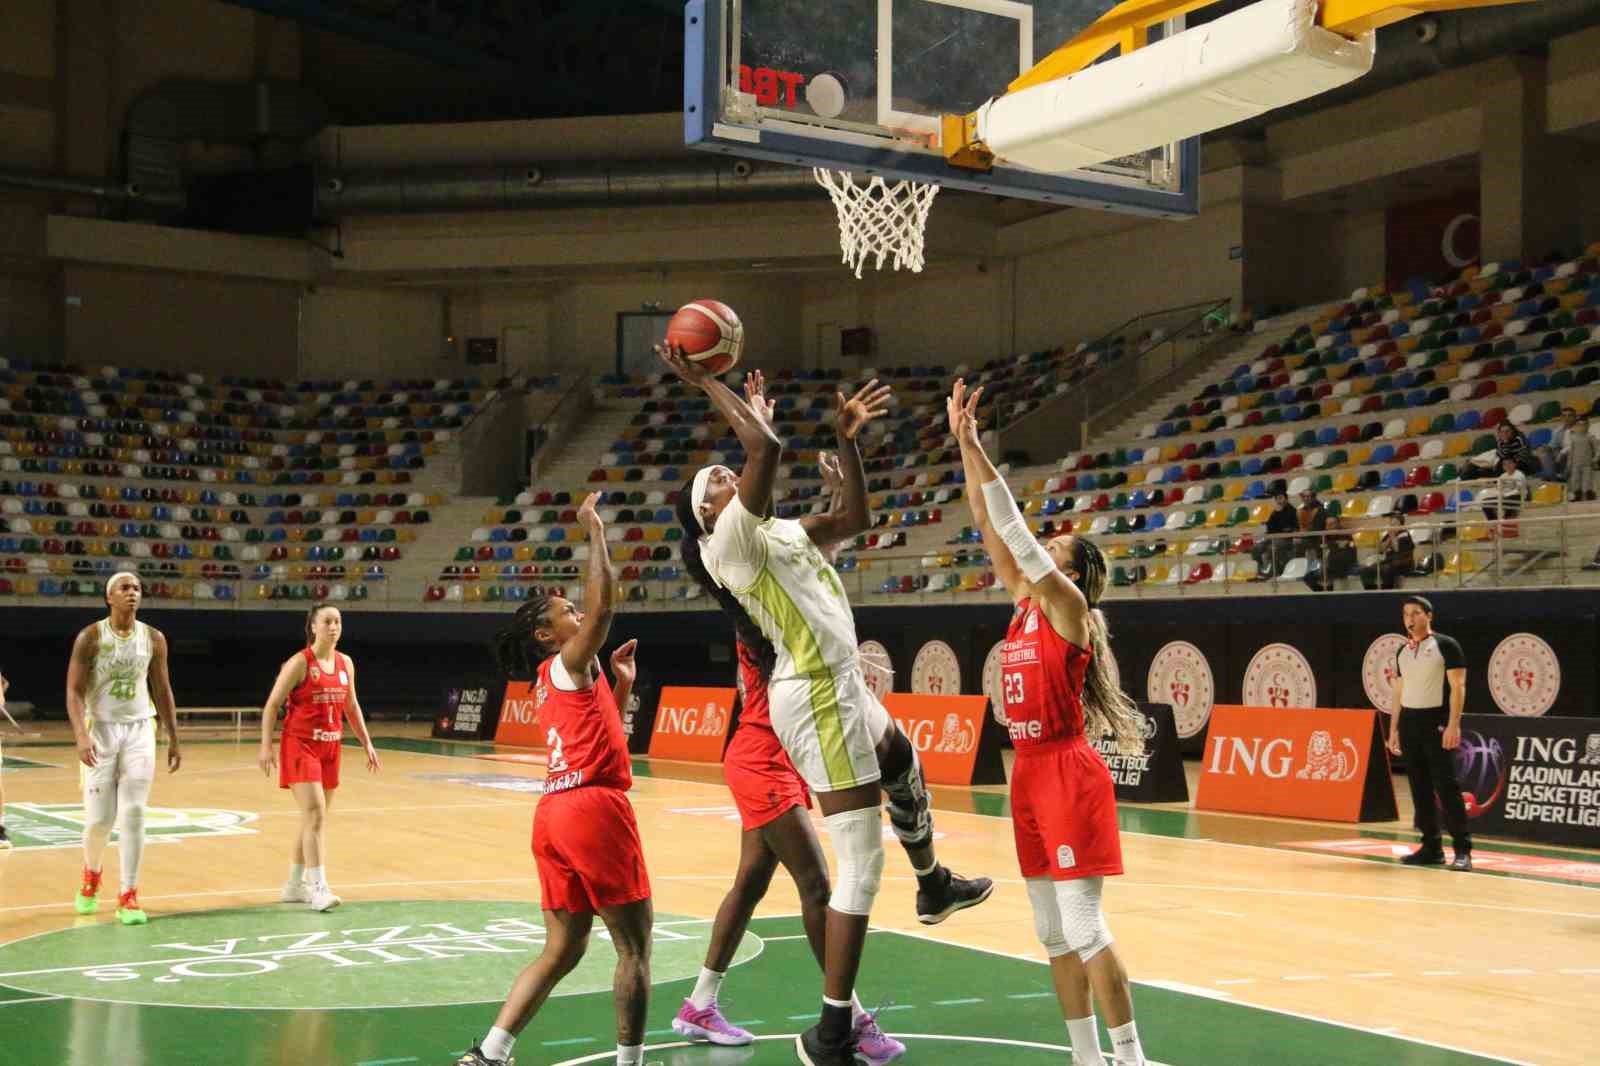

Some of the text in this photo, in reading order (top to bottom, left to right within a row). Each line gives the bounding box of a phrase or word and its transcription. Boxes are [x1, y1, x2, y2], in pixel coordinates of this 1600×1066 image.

[1004, 673, 1024, 705] 23
[502, 699, 531, 724] ING
[656, 707, 697, 736] ING
[894, 718, 935, 752] NG
[1104, 754, 1150, 772] KETBOL
[1207, 735, 1294, 779] ING
[1513, 736, 1577, 764] ING
[1509, 765, 1600, 788] KADINLAR
[1506, 783, 1600, 807] BASKETBO
[1503, 801, 1567, 824] SÜPER
